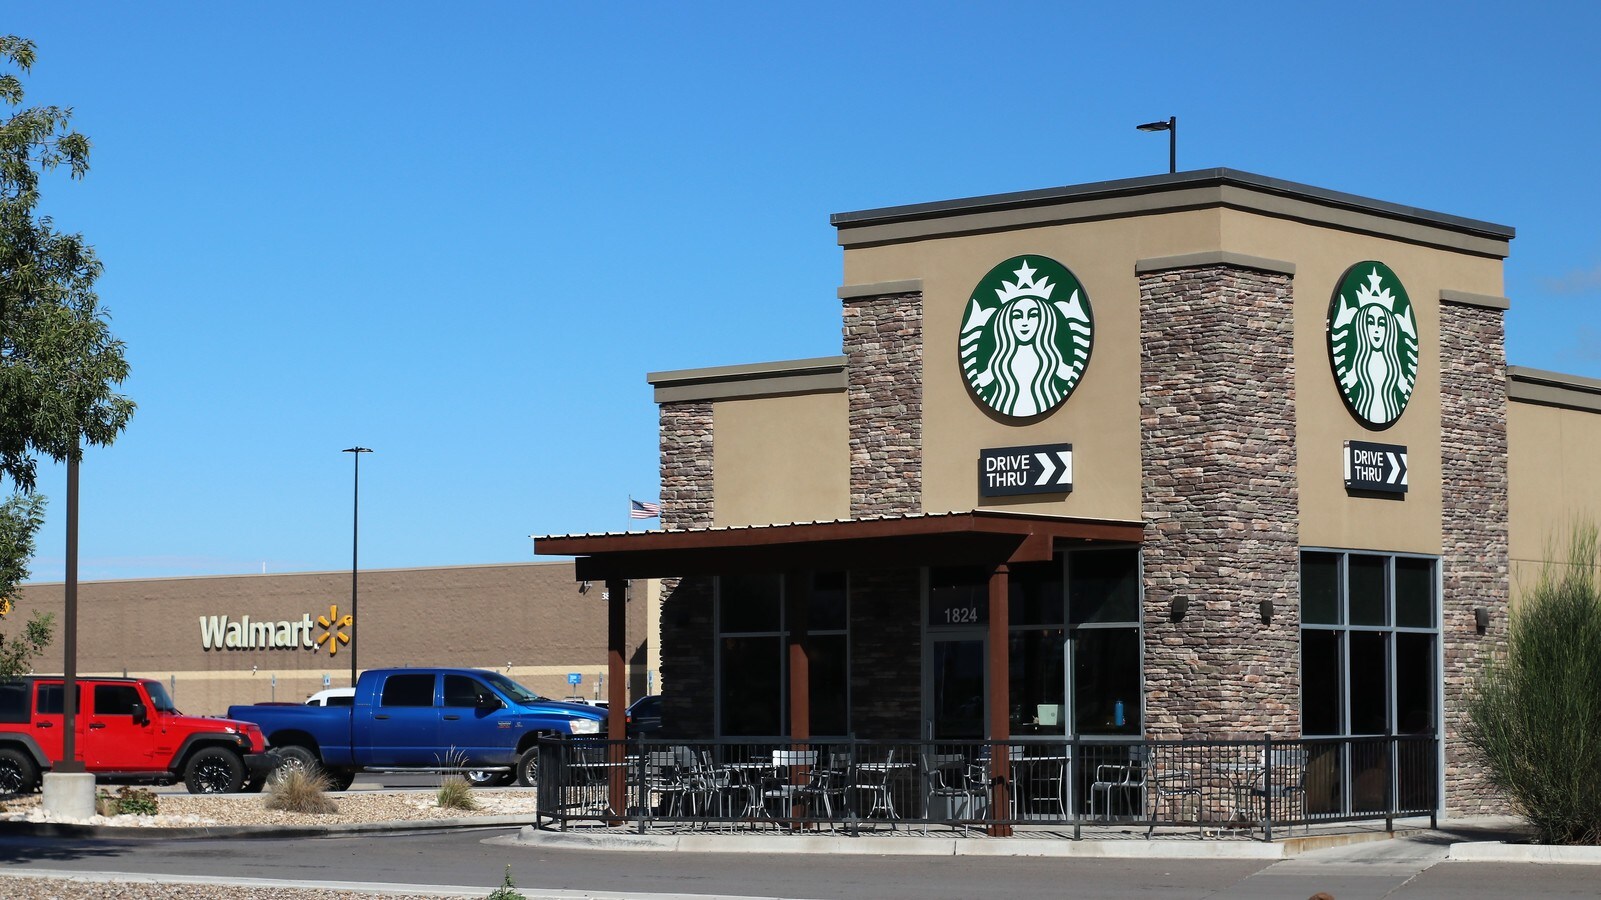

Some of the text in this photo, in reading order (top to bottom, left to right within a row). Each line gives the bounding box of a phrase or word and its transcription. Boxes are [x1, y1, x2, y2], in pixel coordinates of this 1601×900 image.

[986, 454, 1030, 472] DRIVE
[1354, 449, 1384, 466] DRIVE
[986, 471, 1027, 488] THRU
[1354, 465, 1382, 482] THRU
[944, 607, 978, 624] 1824
[199, 613, 314, 649] Walmart
